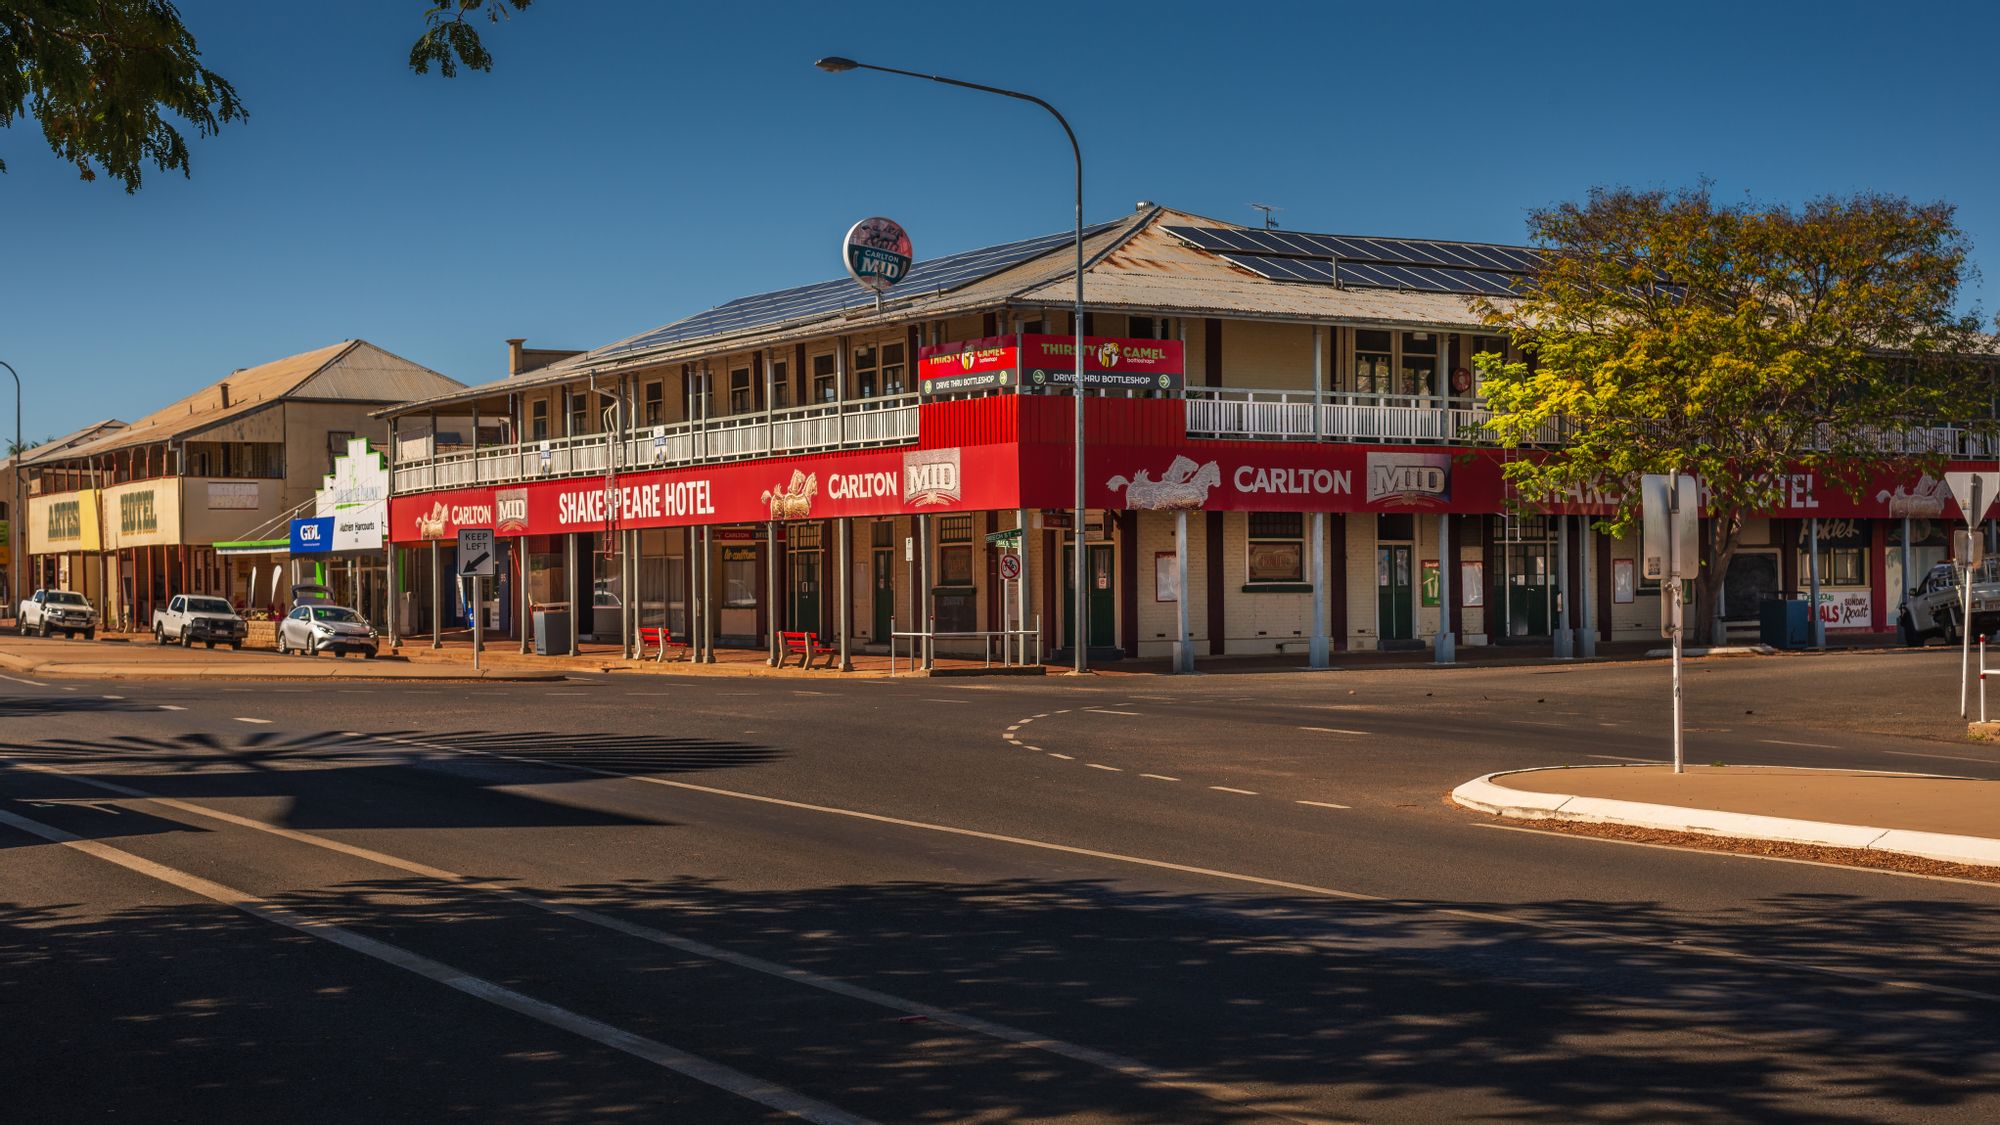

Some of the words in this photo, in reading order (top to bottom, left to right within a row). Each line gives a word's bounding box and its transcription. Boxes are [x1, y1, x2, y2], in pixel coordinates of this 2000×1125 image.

[865, 250, 898, 263] CARLTON
[860, 257, 899, 278] MID
[977, 345, 1006, 357] CAMEL
[1123, 347, 1166, 359] CAMEL
[936, 381, 950, 390] DRIVE
[950, 379, 963, 388] THRU
[963, 375, 995, 386] BOTTLESHOP
[1053, 373, 1077, 382] DRIVE
[1080, 374, 1100, 383] HRU
[1102, 375, 1150, 384] BOTTLESHOP
[828, 471, 897, 500] CARLTON
[908, 462, 957, 494] MID
[1233, 465, 1352, 495] CARLTON
[1373, 464, 1446, 497] MID
[1740, 474, 1819, 508] OTEL
[120, 490, 157, 535] HOTEL
[498, 499, 526, 522] MID
[559, 484, 661, 525] SHAKESPEARE
[665, 480, 715, 517] HOTEL
[452, 505, 492, 526] CARLTON
[300, 524, 321, 541] GDL
[465, 533, 488, 541] KEEP
[1844, 598, 1867, 606] SUNDAY
[1843, 604, 1869, 624] Roast
